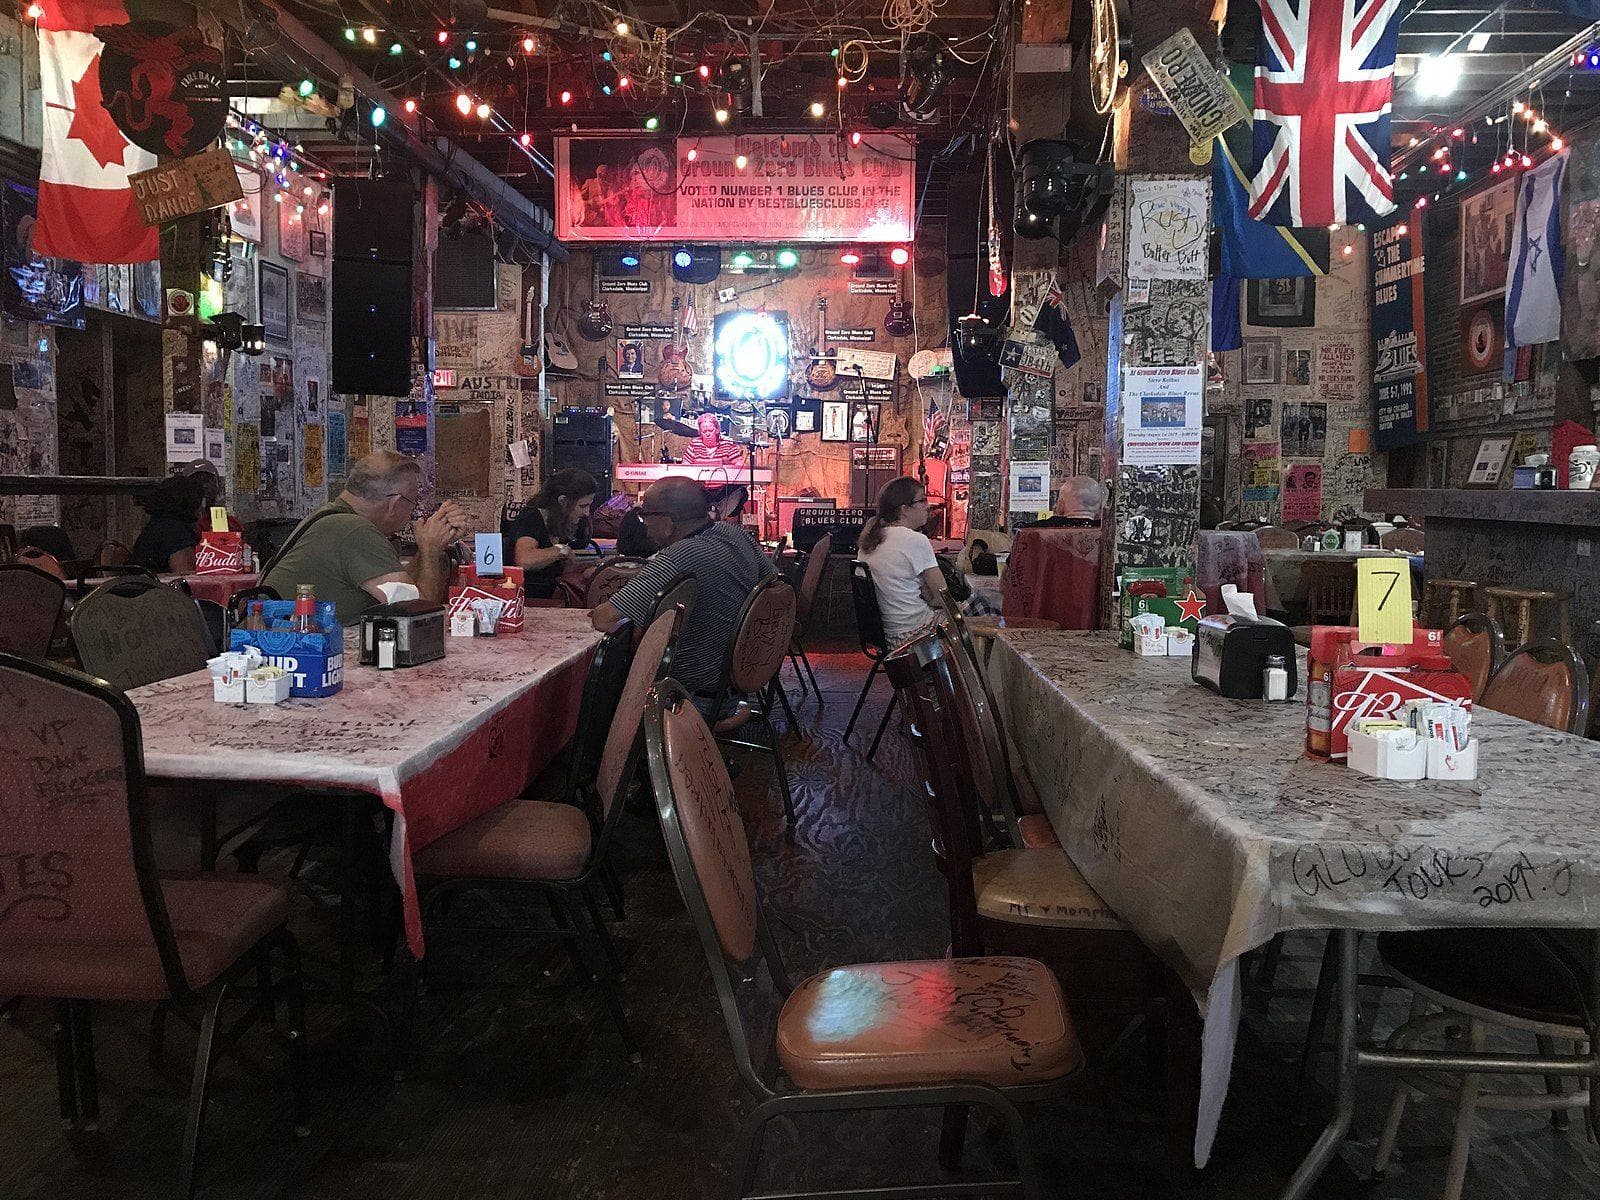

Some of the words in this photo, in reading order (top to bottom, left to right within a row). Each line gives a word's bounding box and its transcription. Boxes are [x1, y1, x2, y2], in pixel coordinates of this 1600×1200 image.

[135, 169, 181, 199] JUST
[681, 186, 718, 197] VOTED
[721, 186, 772, 197] NUMBER
[776, 186, 784, 197] 1
[787, 186, 825, 197] BLUES
[829, 186, 859, 197] CLUB
[862, 186, 875, 197] IN
[879, 186, 902, 197] THE
[143, 192, 200, 222] DANCE
[690, 198, 735, 209] NATION
[739, 198, 754, 209] BY
[1386, 243, 1400, 264] THE
[1375, 255, 1425, 287] SUMMERTIME
[1375, 284, 1398, 306] BLUES
[800, 508, 836, 516] GROUND
[839, 508, 864, 517] ZERO
[805, 516, 835, 525] BLUES
[839, 517, 864, 525] CLUB
[484, 545, 495, 566] 6
[1371, 572, 1401, 611] 7
[1138, 599, 1146, 609] 6
[1428, 631, 1437, 641] 6
